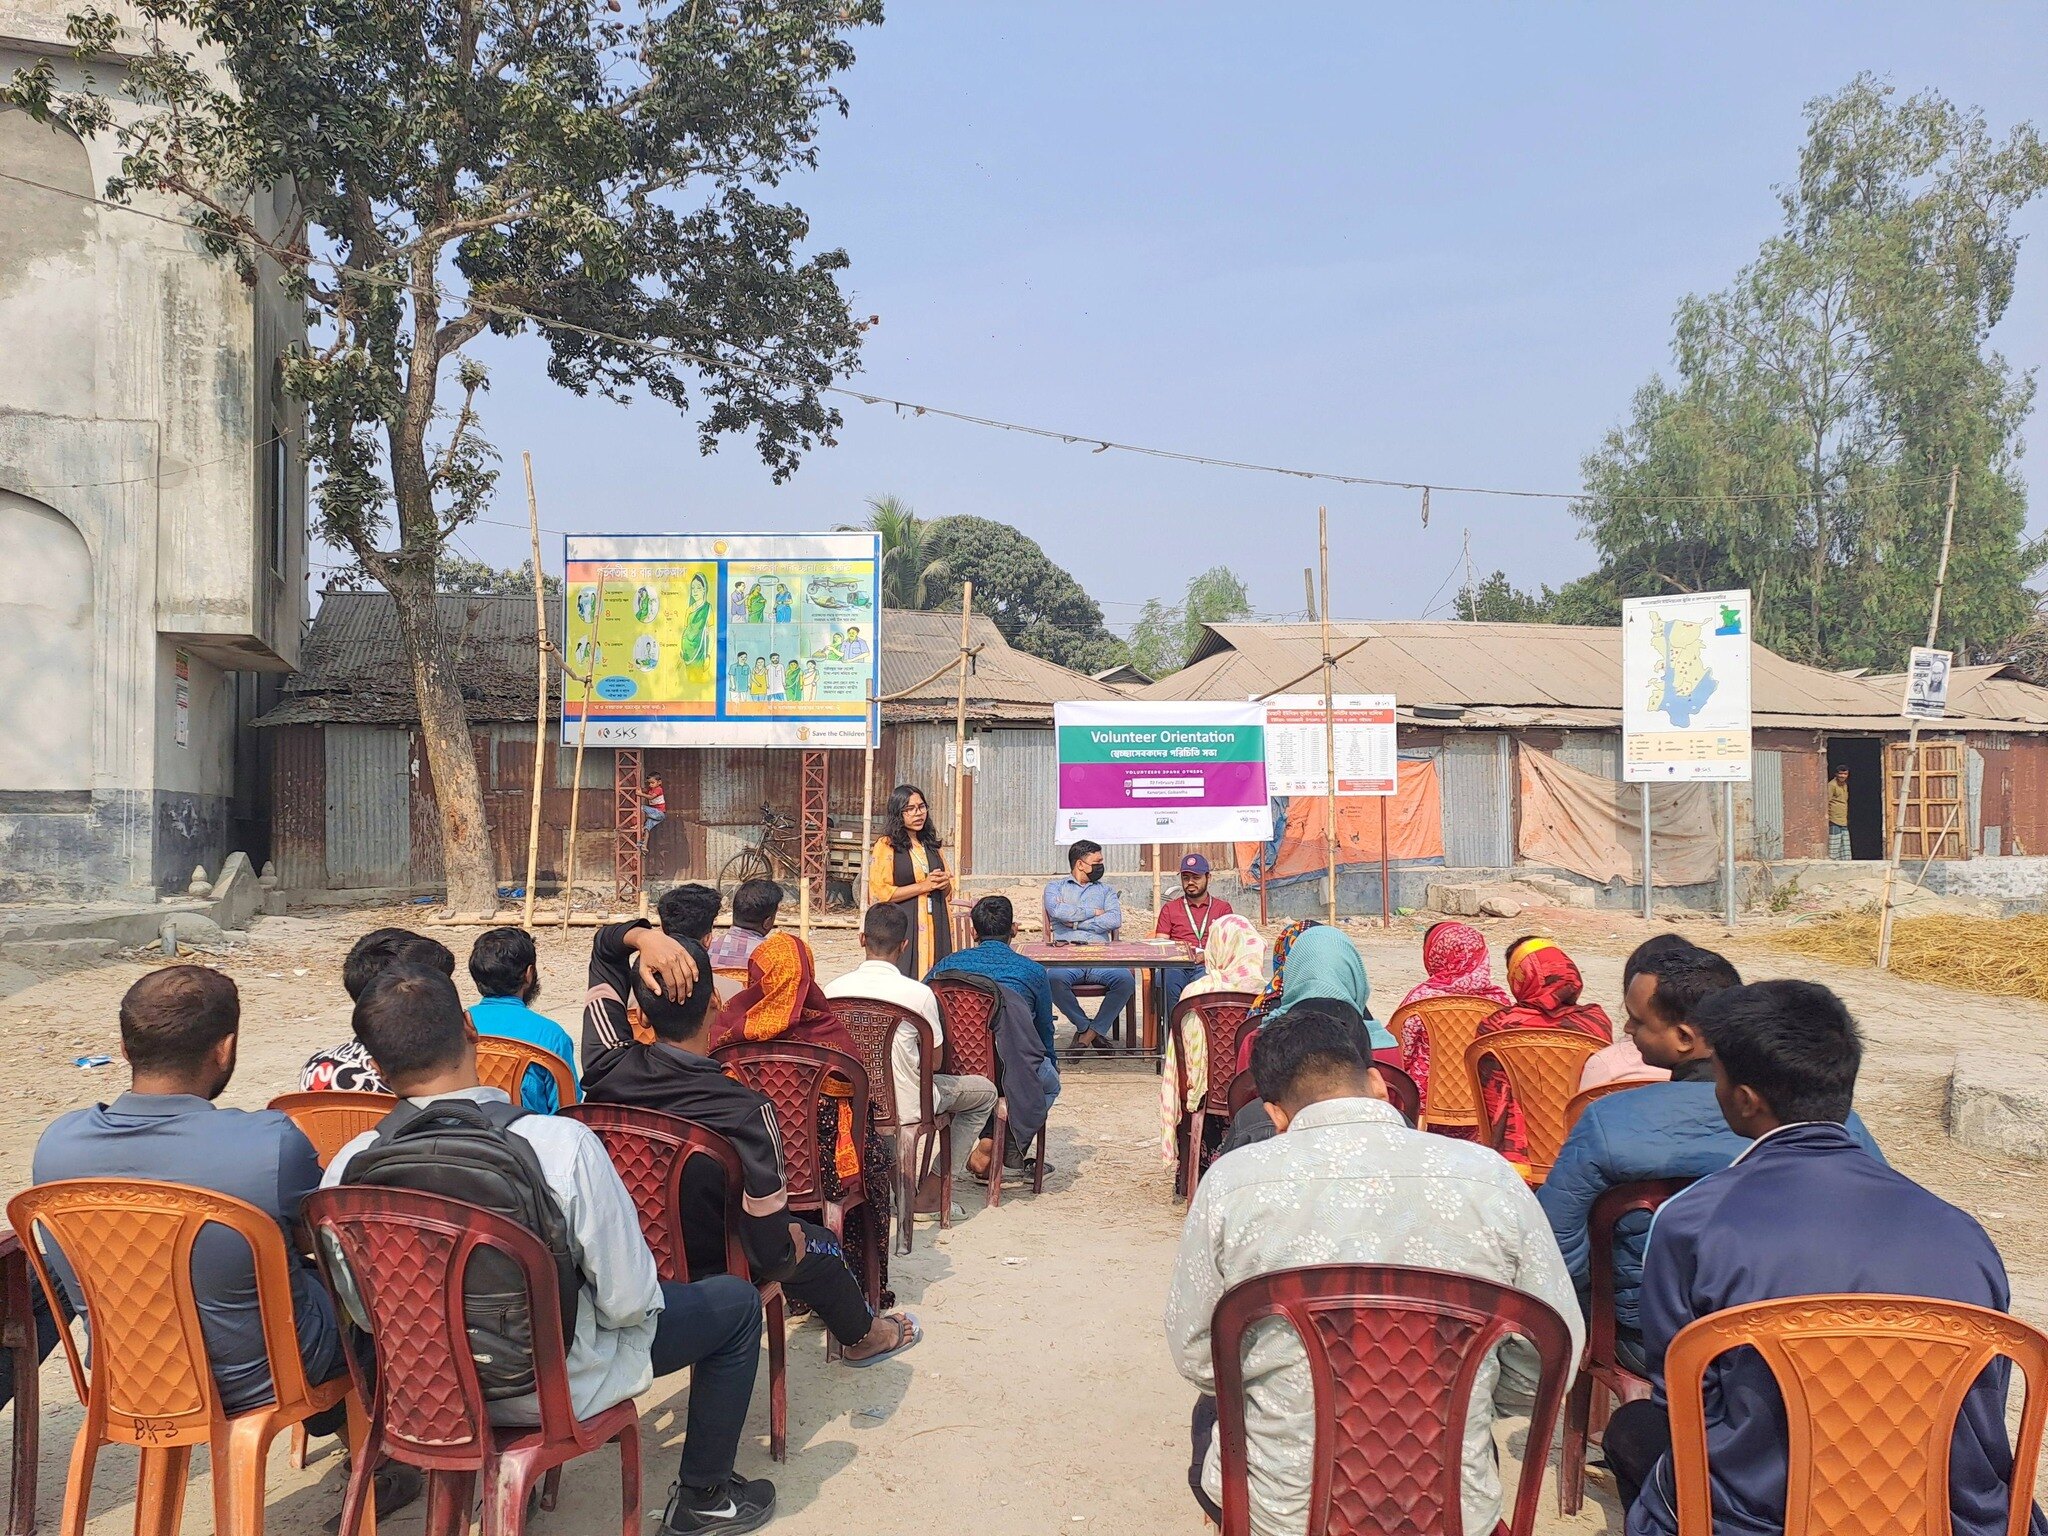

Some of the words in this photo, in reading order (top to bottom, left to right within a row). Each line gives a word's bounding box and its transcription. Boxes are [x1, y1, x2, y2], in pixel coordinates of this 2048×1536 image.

[613, 726, 637, 739] SKS
[1091, 731, 1157, 743] Volunteer
[1160, 730, 1235, 743] Orientation
[134, 1418, 178, 1444] BK-3
